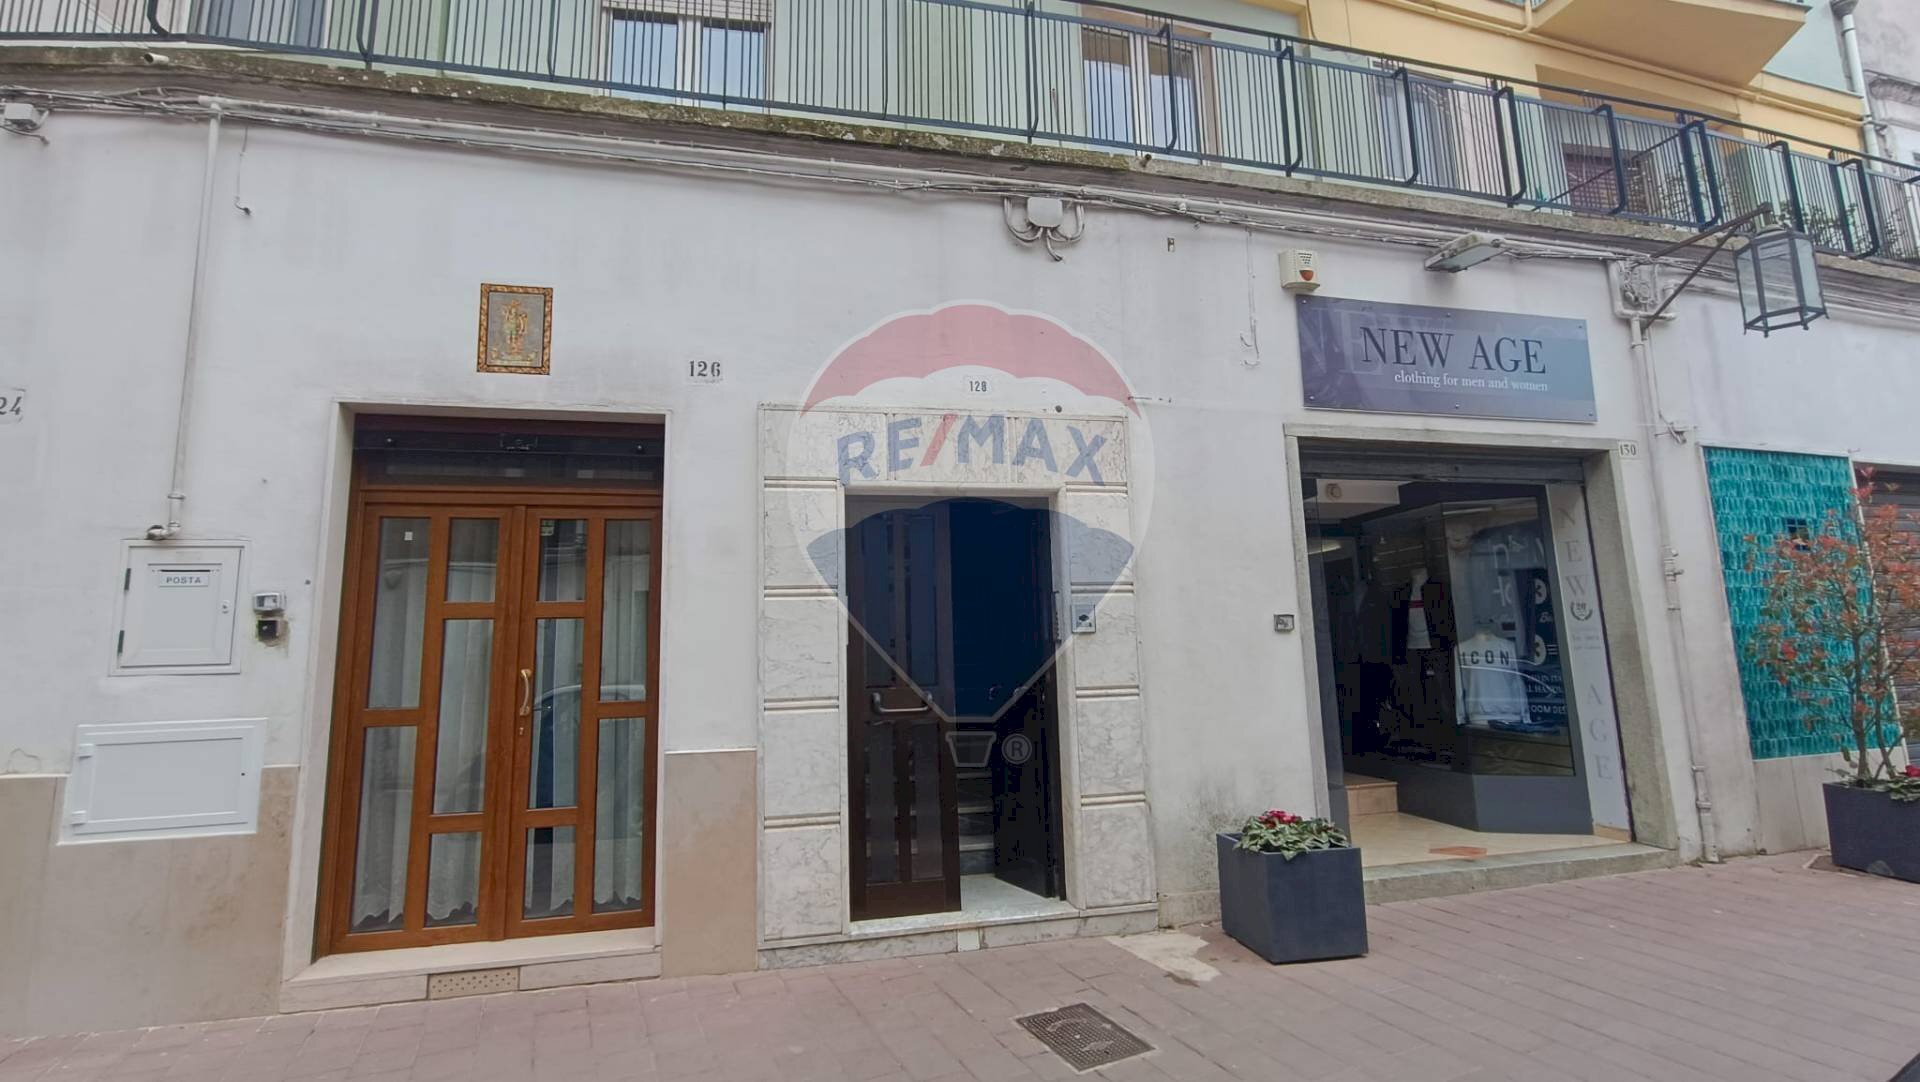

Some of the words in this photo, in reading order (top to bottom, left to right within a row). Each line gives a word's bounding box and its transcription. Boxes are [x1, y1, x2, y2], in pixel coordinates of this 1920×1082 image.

[1360, 326, 1454, 368] NEW
[1468, 335, 1547, 374] AGE
[690, 360, 721, 377] 126
[969, 380, 987, 392] 128
[1394, 370, 1441, 388] clothing
[1443, 373, 1458, 386] for
[1461, 378, 1485, 388] men
[1488, 377, 1508, 389] and
[1510, 381, 1548, 392] women
[166, 576, 202, 584] POSTA
[1461, 650, 1510, 666] ICON
